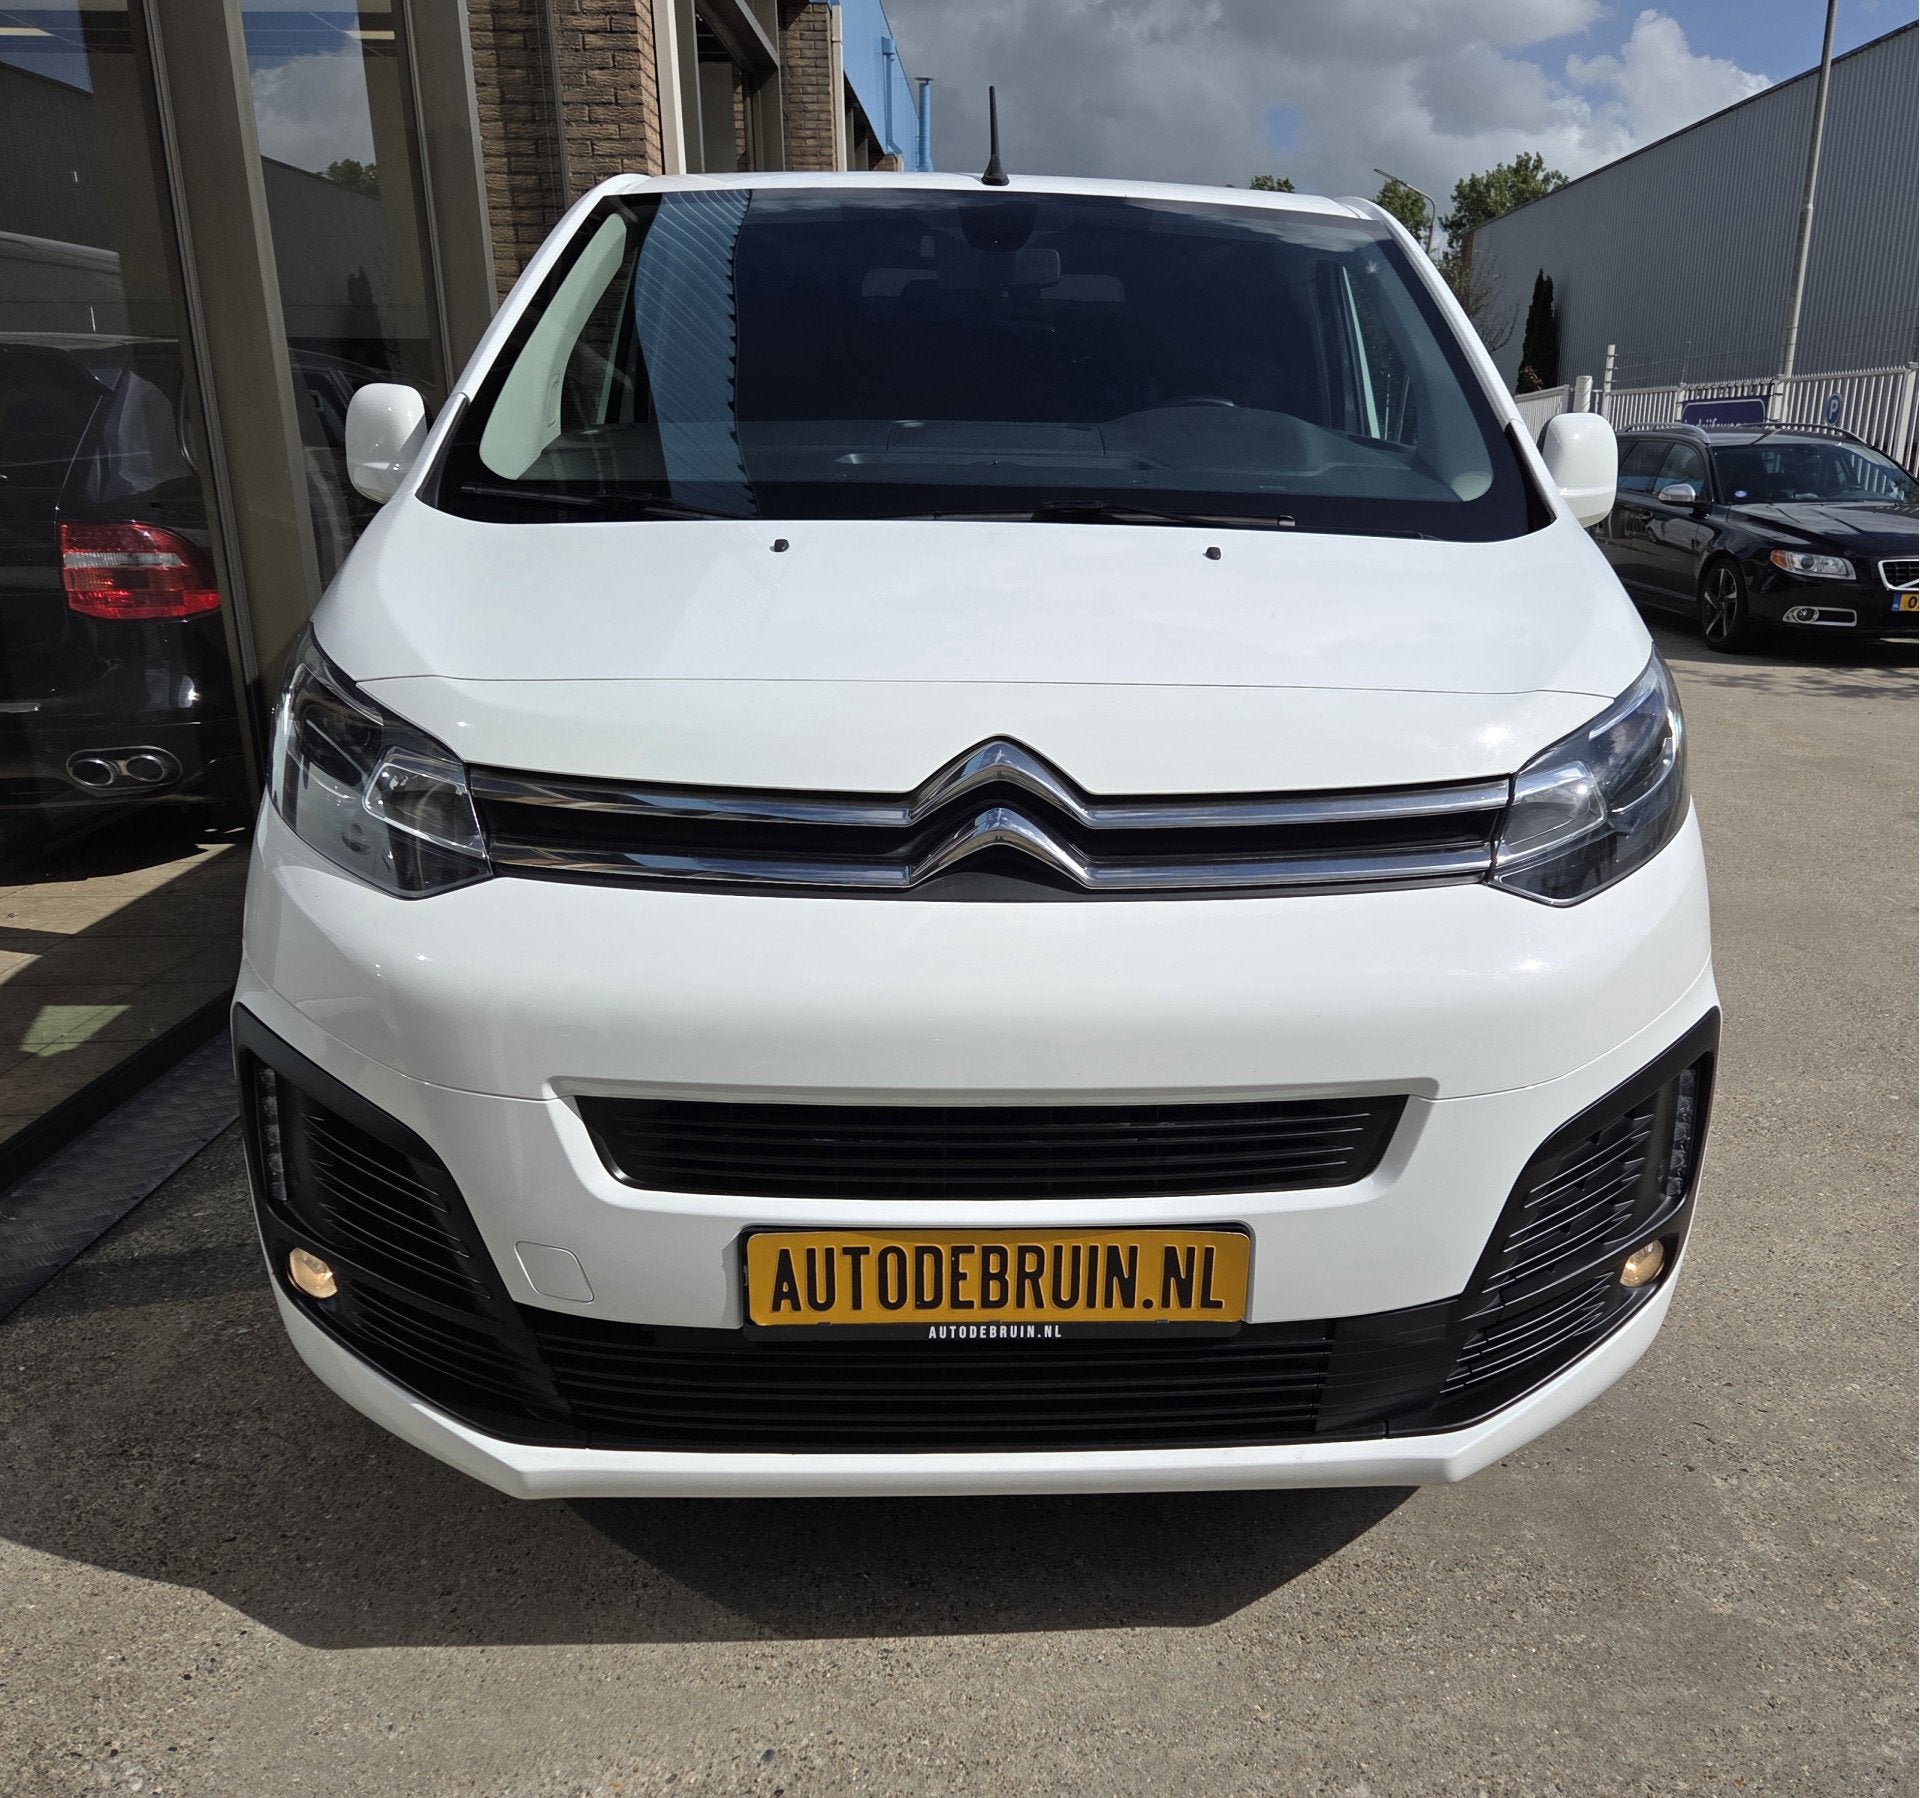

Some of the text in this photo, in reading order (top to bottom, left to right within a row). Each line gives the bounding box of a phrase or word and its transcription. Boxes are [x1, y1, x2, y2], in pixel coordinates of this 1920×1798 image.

[1829, 399, 1839, 420] P
[771, 1245, 1224, 1312] AUTODEBRUIN.NL
[928, 1325, 1062, 1339] AUTODEBRUIN.NL
